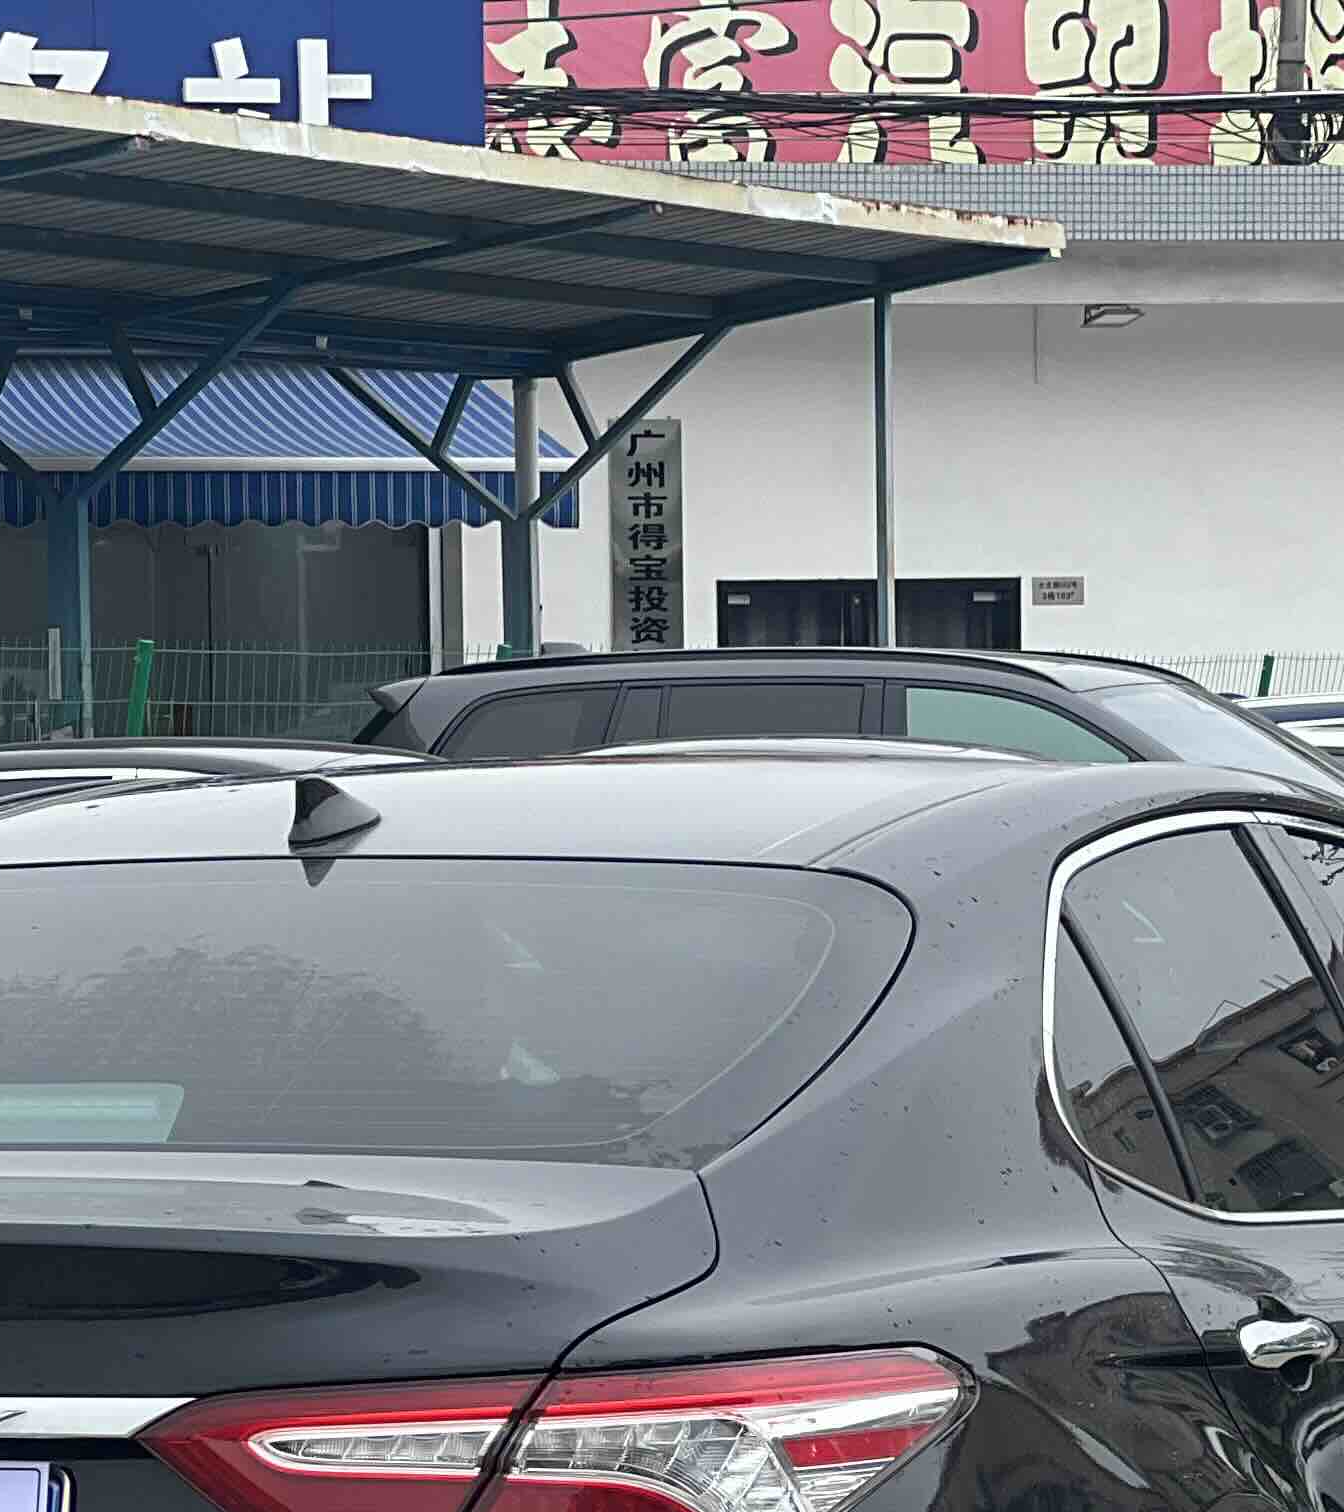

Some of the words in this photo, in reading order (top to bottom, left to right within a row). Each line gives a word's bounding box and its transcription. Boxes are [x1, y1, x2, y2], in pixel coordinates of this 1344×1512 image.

[627, 430, 670, 644] 广州市得宝投资
